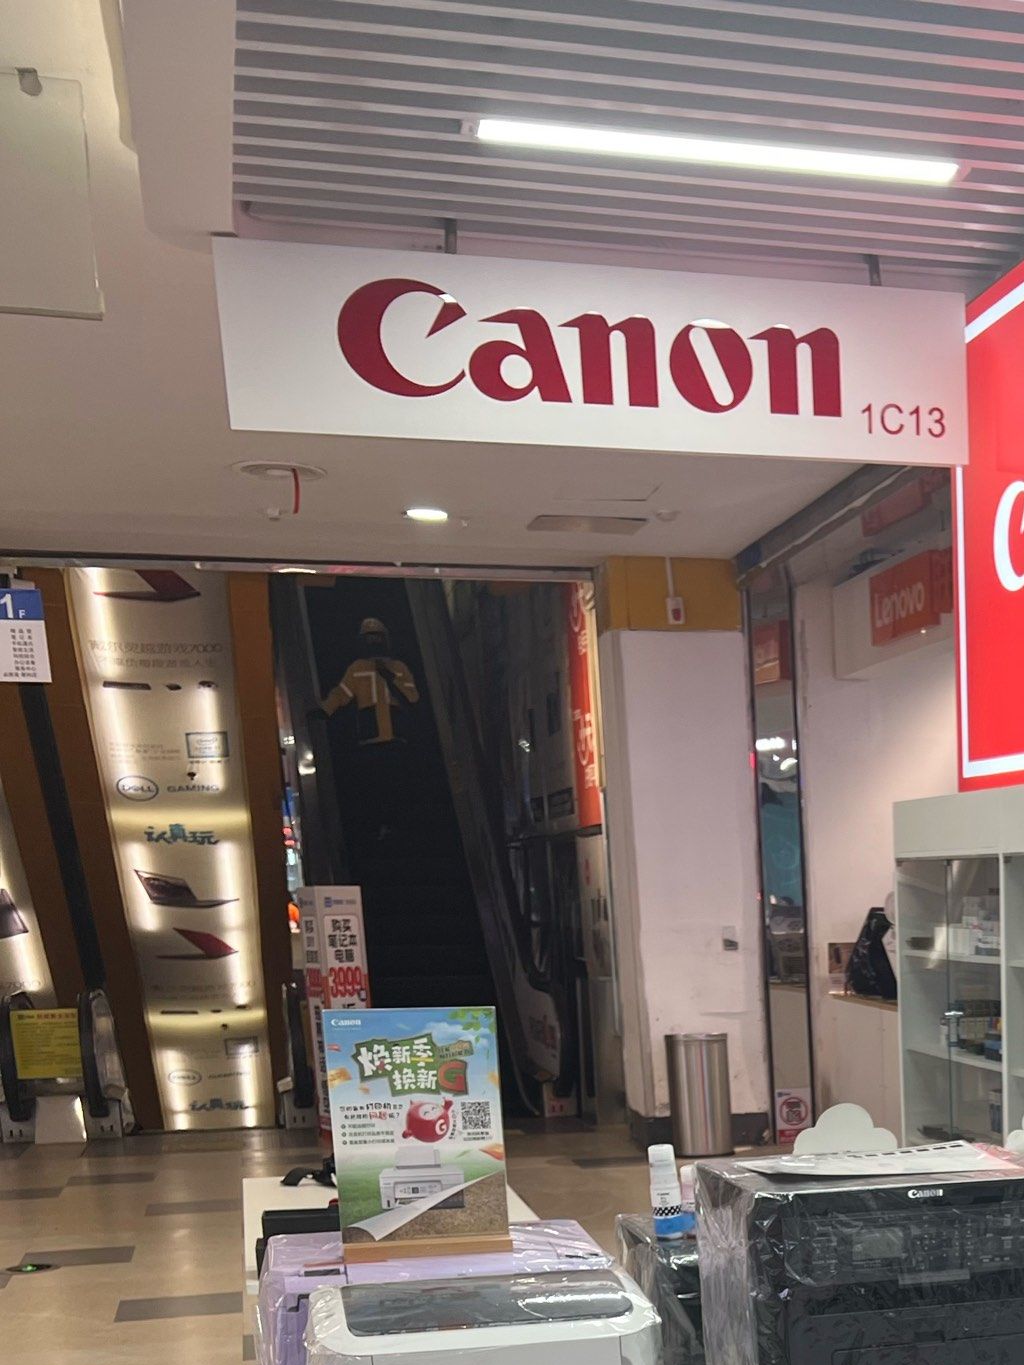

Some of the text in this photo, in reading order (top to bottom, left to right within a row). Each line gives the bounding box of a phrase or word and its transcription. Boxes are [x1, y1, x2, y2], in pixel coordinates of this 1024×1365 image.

[337, 278, 842, 417] Canon
[860, 403, 946, 438] 1C13
[874, 582, 925, 628] Lenovo
[167, 783, 220, 793] GAMING
[328, 934, 357, 949] 笔记本
[334, 949, 355, 963] 电脑
[330, 1018, 362, 1027] Canon
[908, 1189, 943, 1198] Canon
